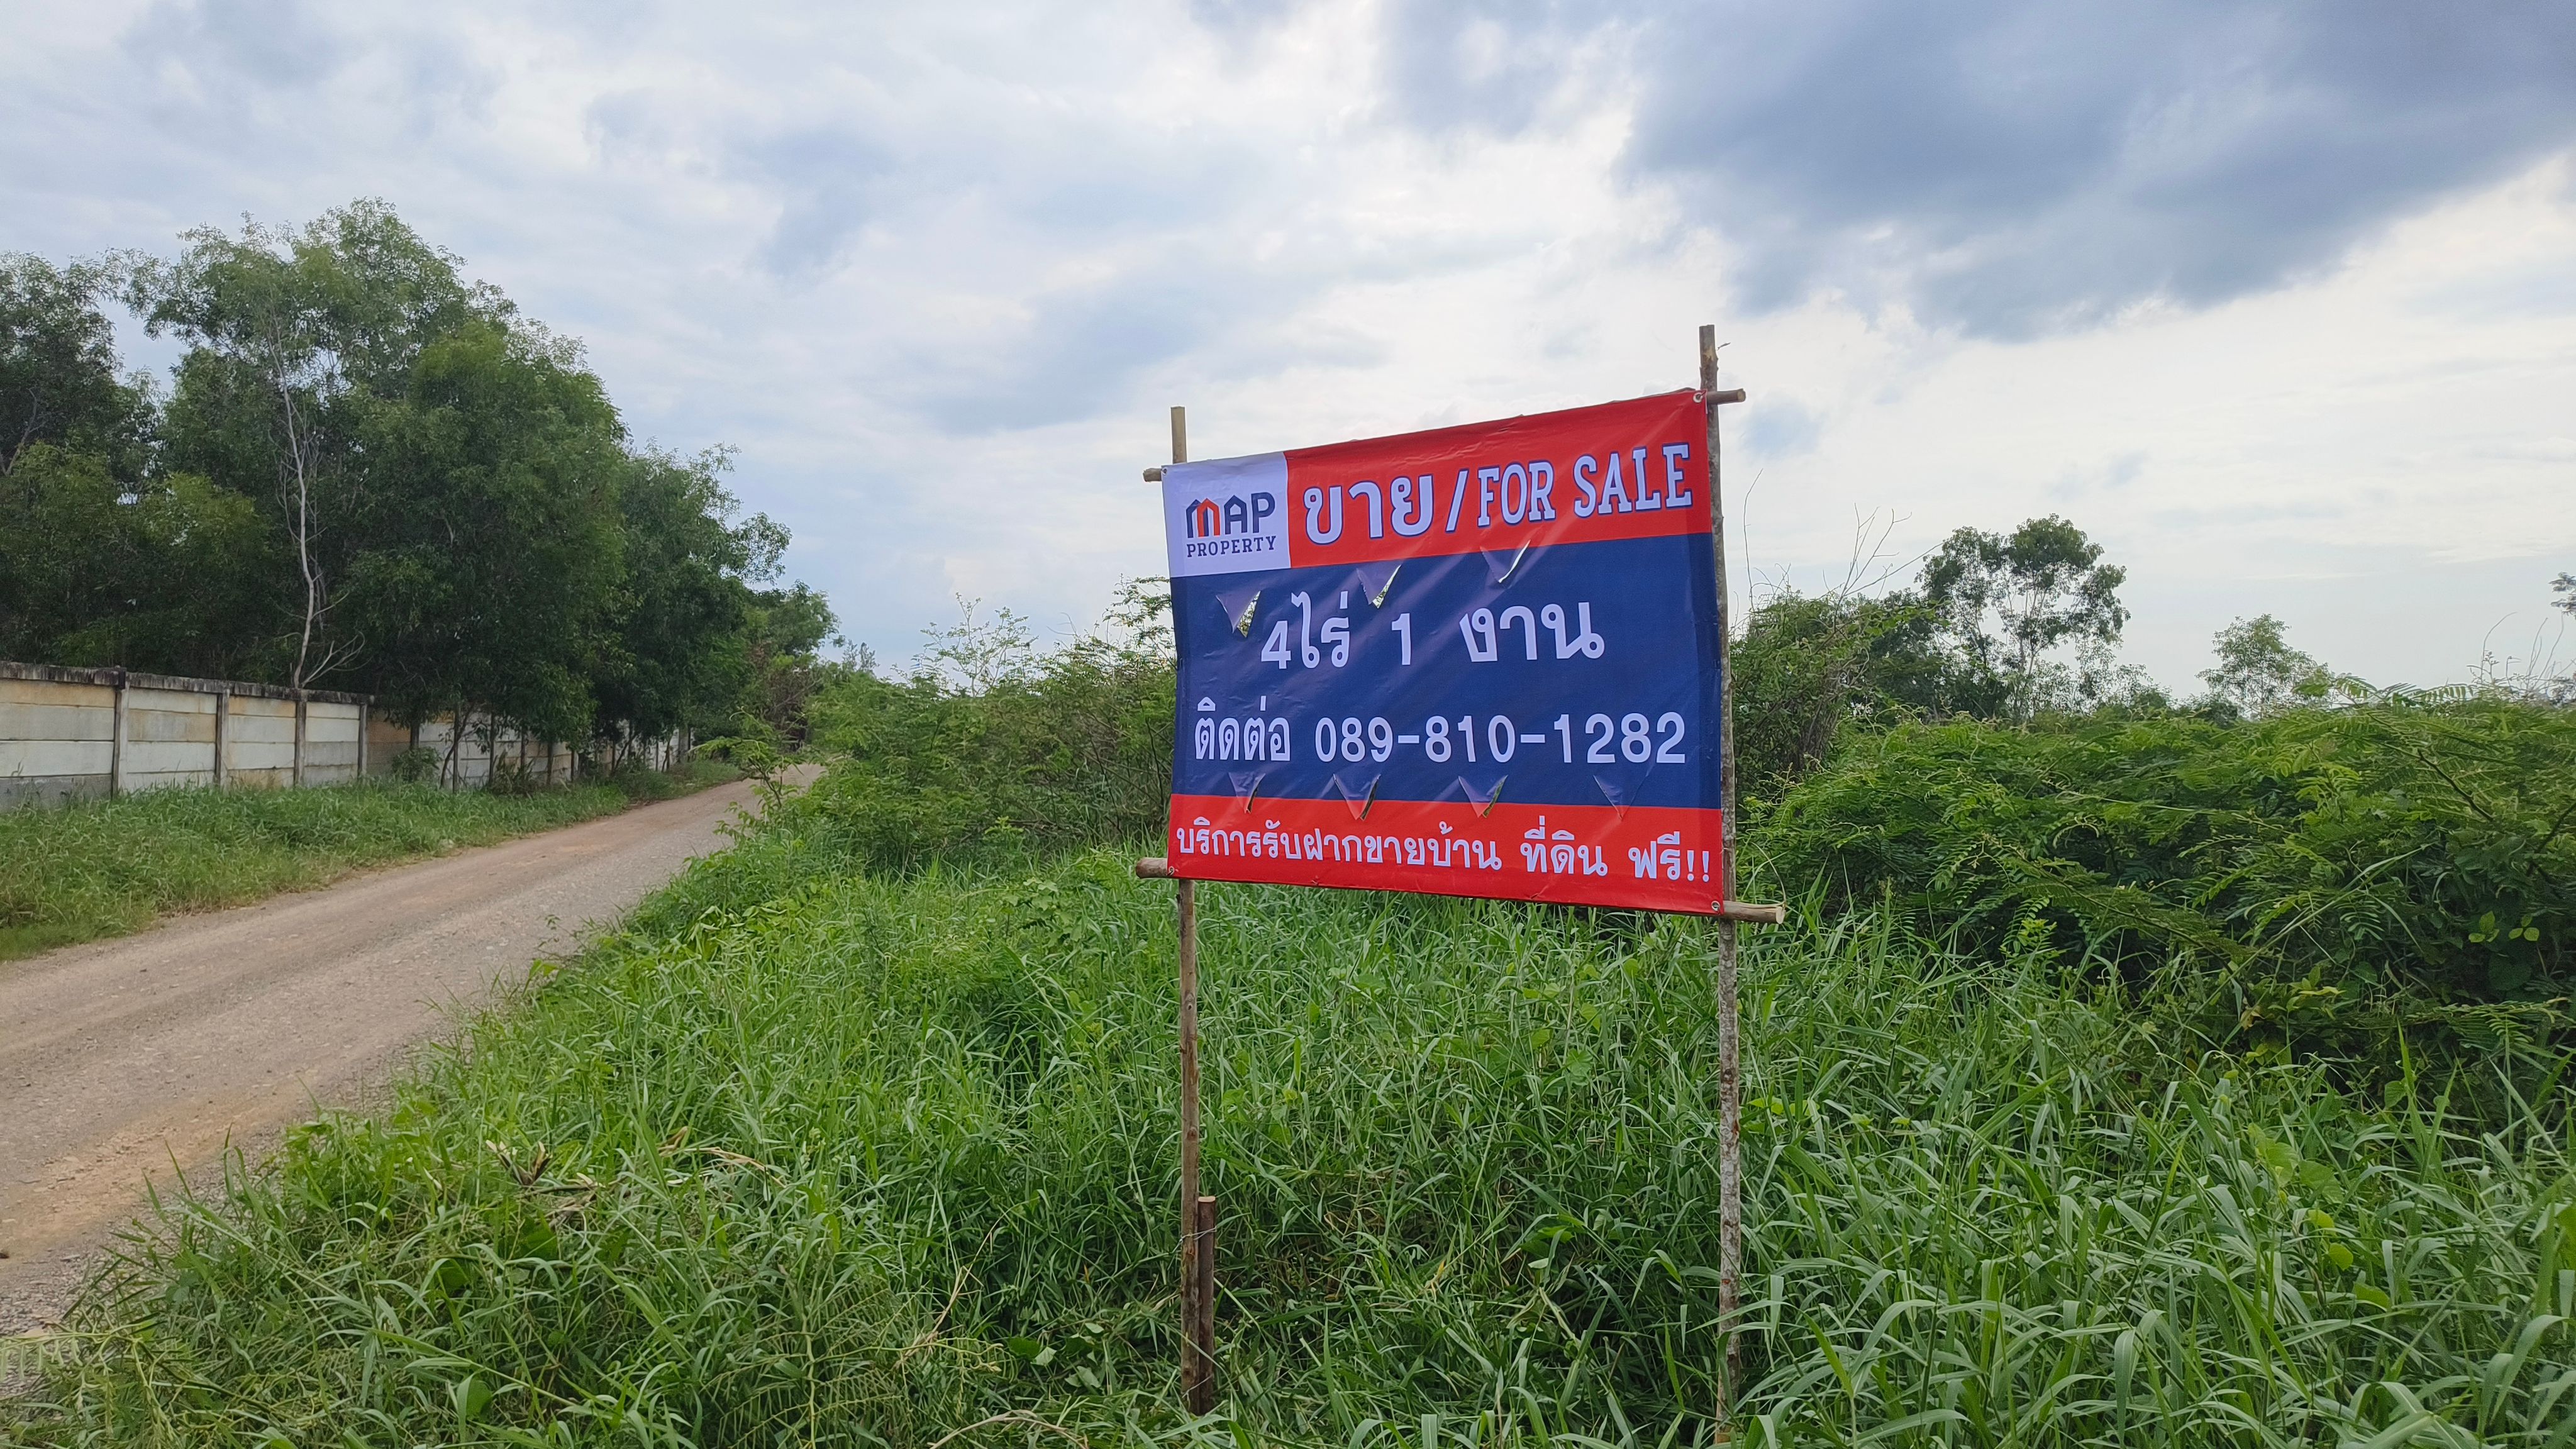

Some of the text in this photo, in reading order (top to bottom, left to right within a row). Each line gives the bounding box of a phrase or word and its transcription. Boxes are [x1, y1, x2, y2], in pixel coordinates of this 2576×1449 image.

[1185, 492, 1276, 539] MAP
[1303, 474, 1433, 545] ขาย
[1573, 443, 1692, 518] SALE
[1186, 535, 1276, 558] PROPERTY
[1391, 613, 1411, 665] 1
[1459, 602, 1606, 662] งาน
[1194, 696, 1686, 763] ติดต่อ 089-810-1282
[1177, 815, 1710, 882] บริการรับฝากขายบ้าน ที่ดิน ฟรี!!
